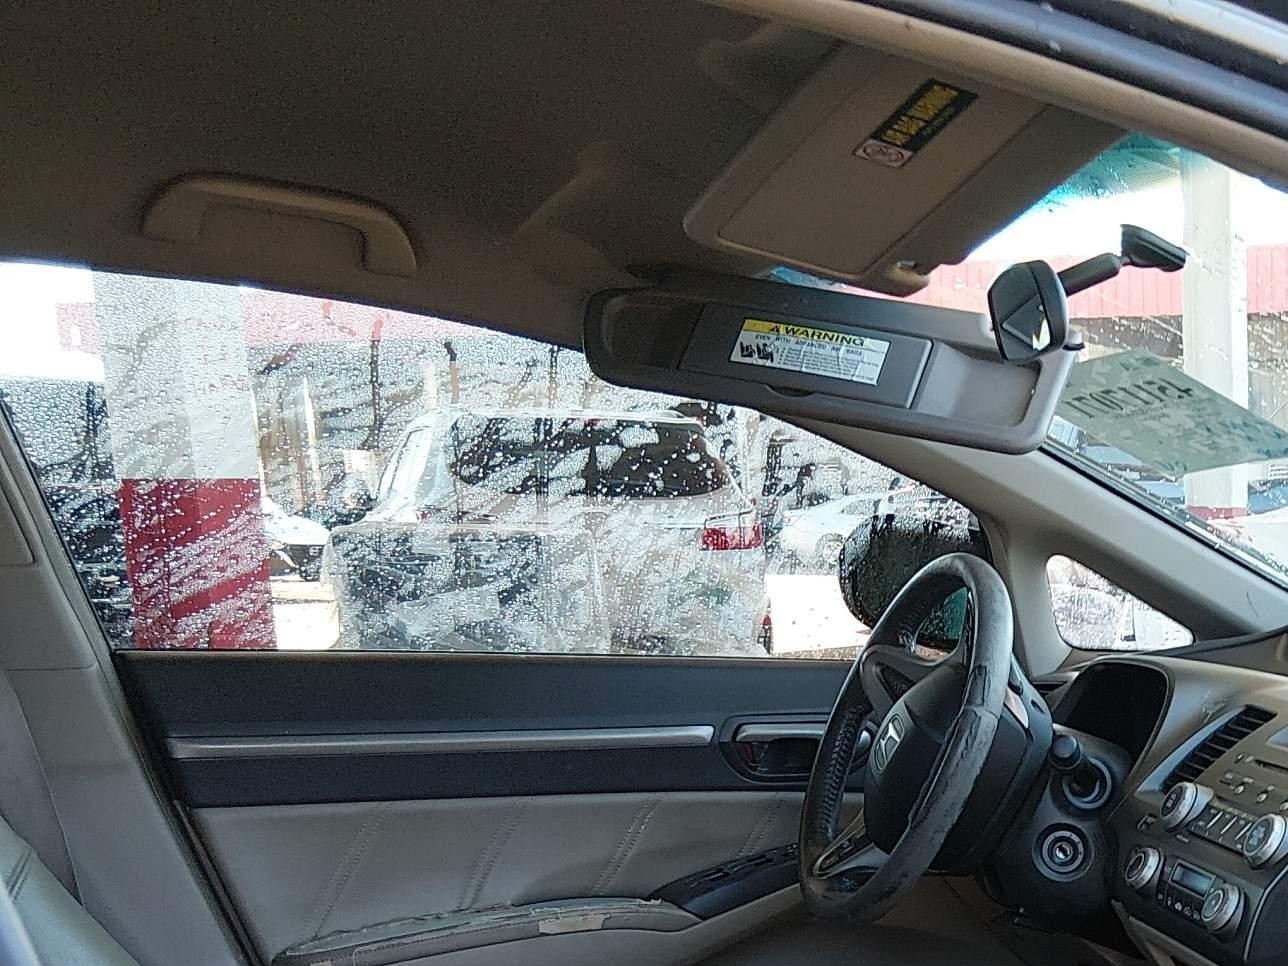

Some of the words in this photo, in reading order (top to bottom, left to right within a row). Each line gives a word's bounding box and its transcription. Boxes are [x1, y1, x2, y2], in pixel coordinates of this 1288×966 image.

[775, 336, 791, 345] WITH
[795, 339, 827, 350] ADVANCED
[784, 325, 865, 347] WARNING
